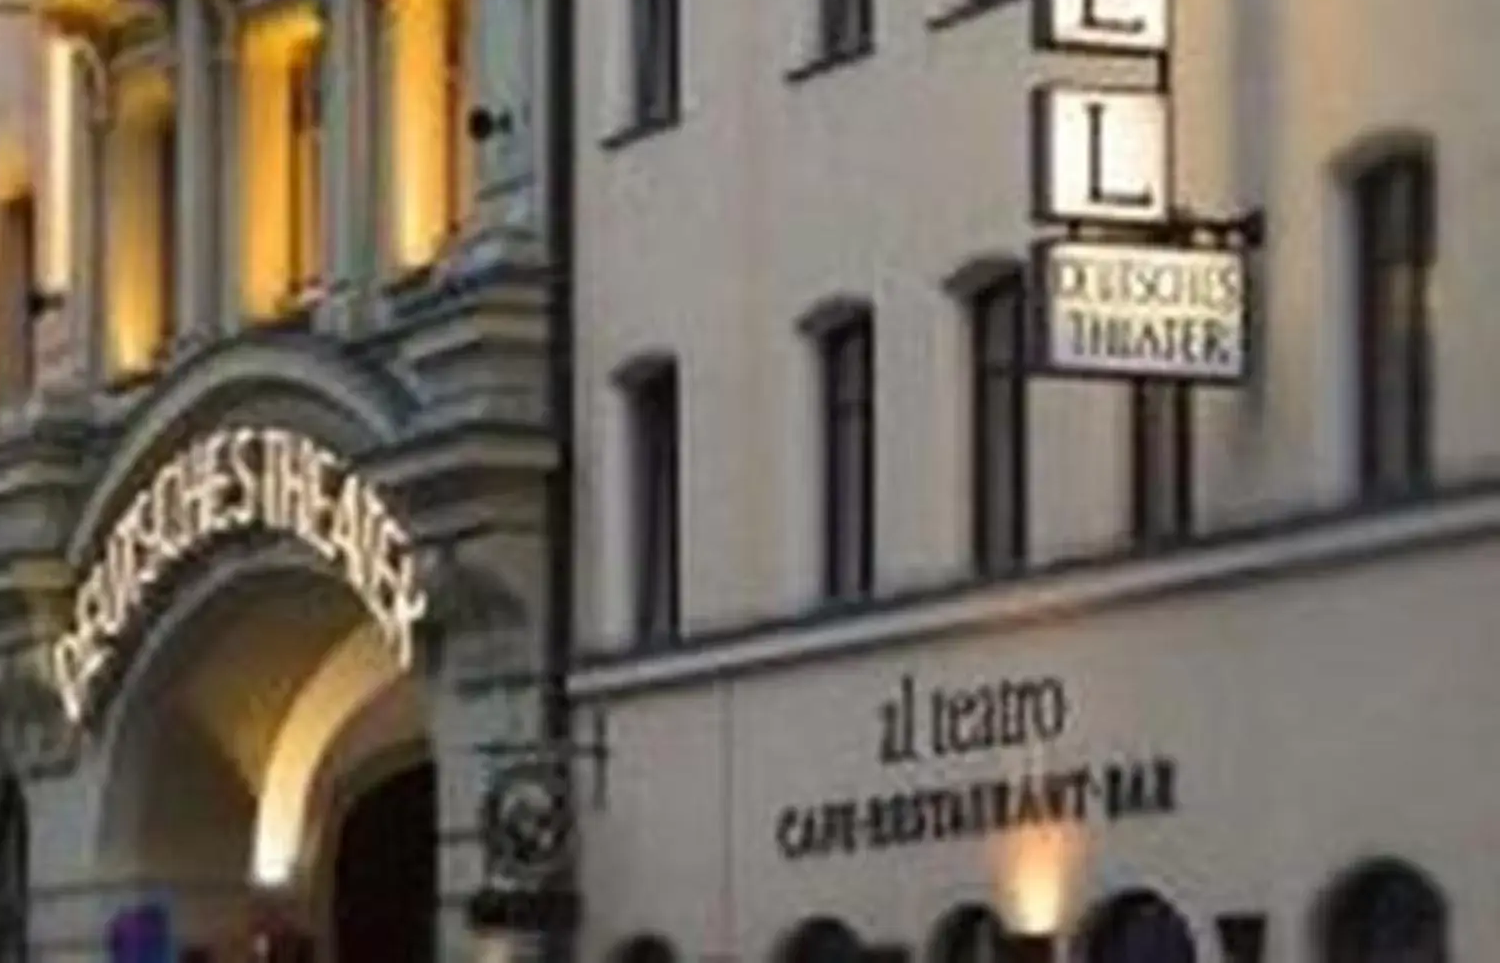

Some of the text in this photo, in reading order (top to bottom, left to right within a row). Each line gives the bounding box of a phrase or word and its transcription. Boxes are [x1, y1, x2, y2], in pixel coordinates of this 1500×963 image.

[1069, 309, 1231, 365] THEATER
[53, 426, 428, 723] DEUTSCHES THEATER
[931, 677, 1066, 755] teatro
